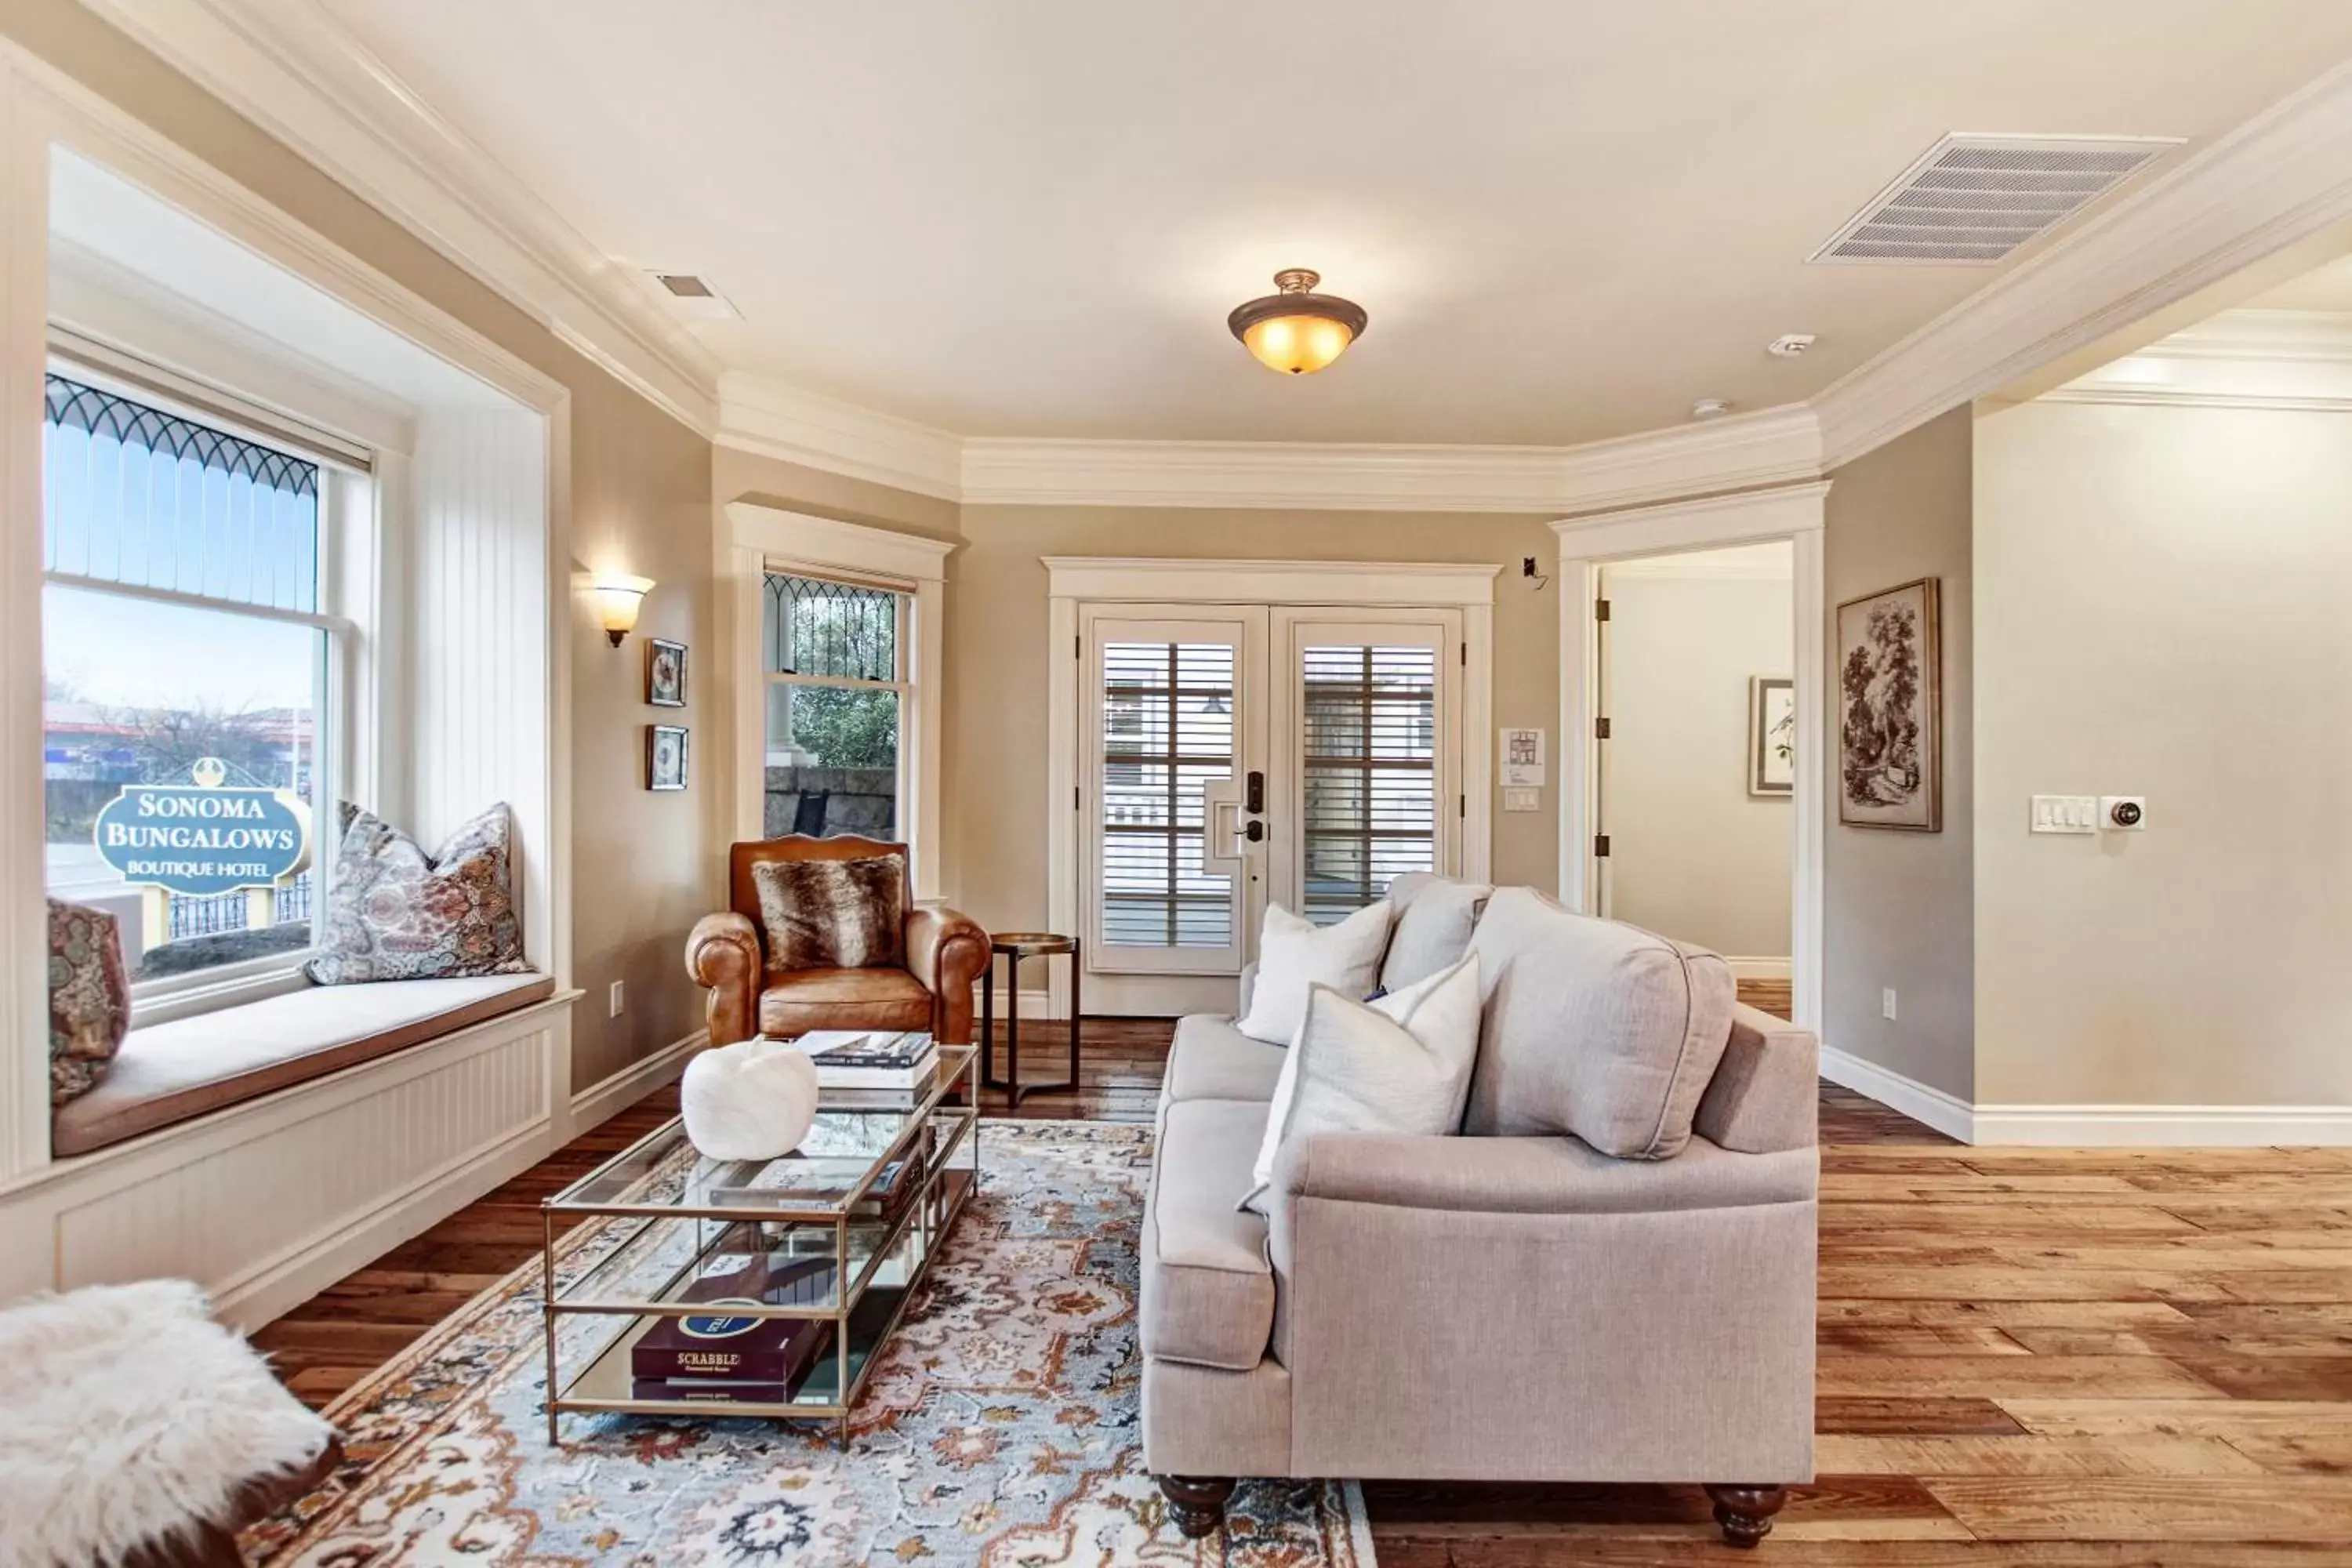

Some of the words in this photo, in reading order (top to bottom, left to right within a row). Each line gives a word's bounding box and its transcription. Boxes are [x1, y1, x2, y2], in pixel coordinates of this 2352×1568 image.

[138, 793, 266, 819] SONOMA
[106, 822, 294, 850] BUNGALOWS
[127, 860, 214, 878] BOUTIQUE
[218, 862, 270, 877] HOTEL
[677, 1352, 739, 1365] SCRABBLE
